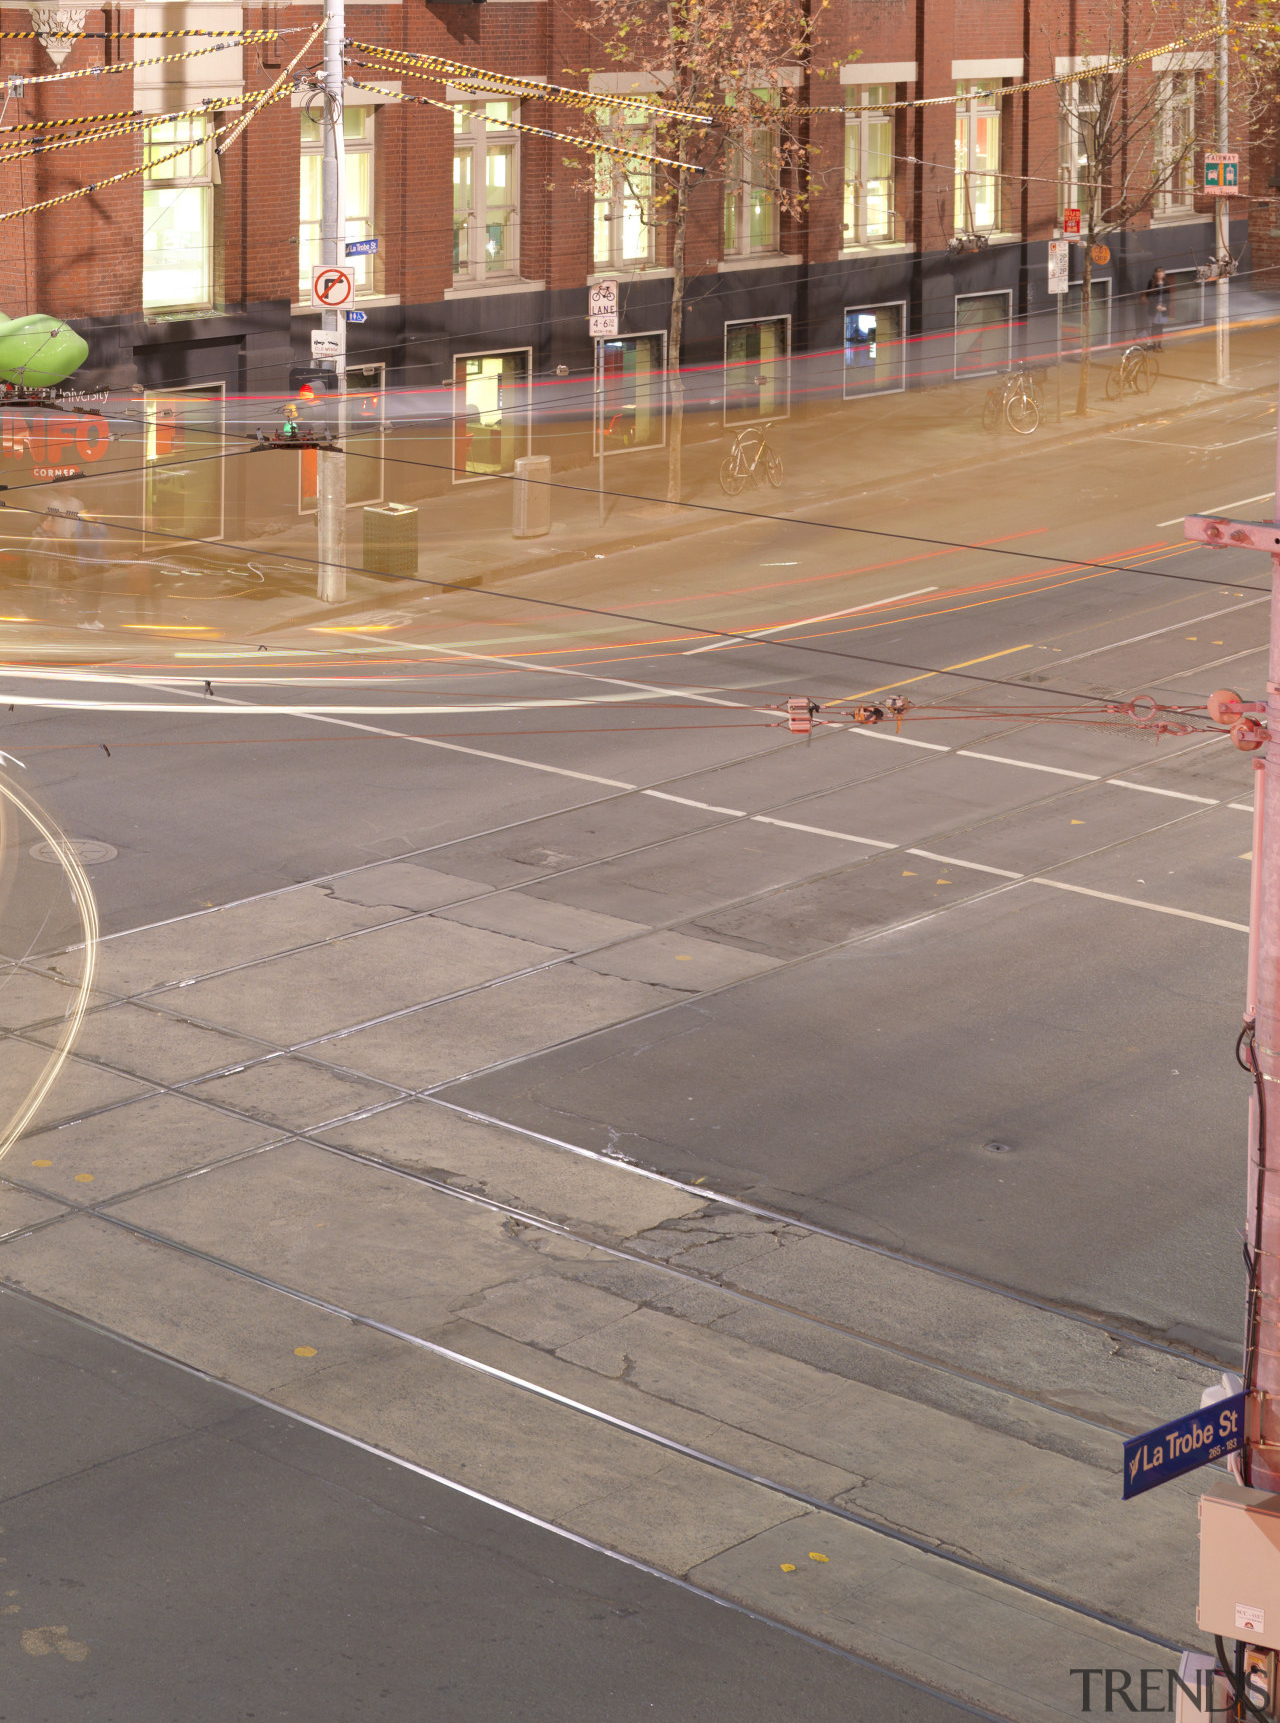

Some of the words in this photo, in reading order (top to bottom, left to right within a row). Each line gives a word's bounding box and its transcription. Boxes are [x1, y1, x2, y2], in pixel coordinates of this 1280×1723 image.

[350, 244, 357, 252] La
[357, 242, 370, 251] Trobe
[370, 241, 377, 249] St
[592, 306, 615, 315] LANE
[2, 411, 109, 463] INFO
[33, 468, 75, 477] CORNER
[1143, 1445, 1163, 1471] La
[1166, 1424, 1213, 1460] Trobe
[1219, 1410, 1238, 1437] St
[1209, 1445, 1221, 1459] 265
[1226, 1438, 1238, 1451] 183
